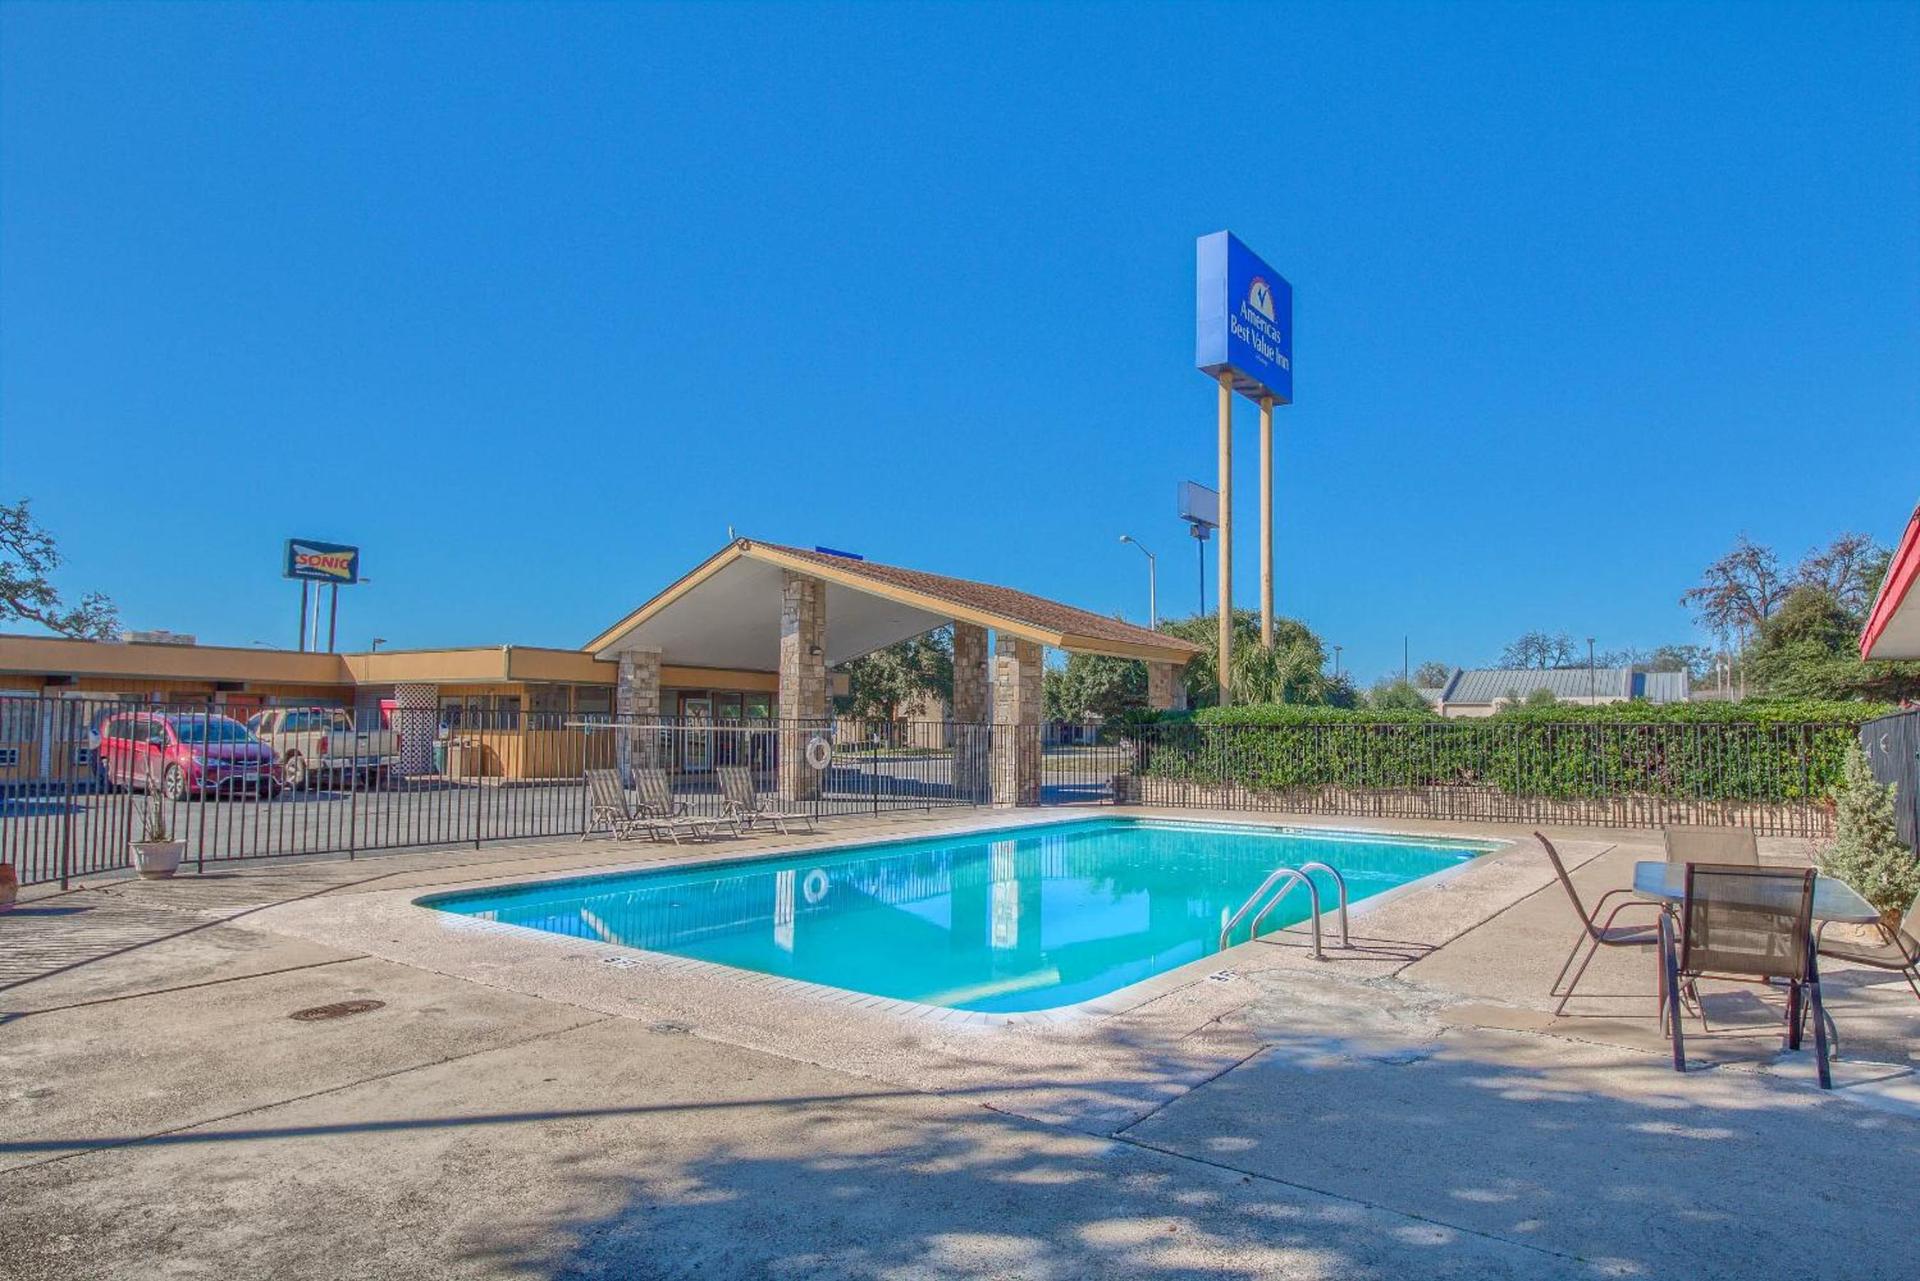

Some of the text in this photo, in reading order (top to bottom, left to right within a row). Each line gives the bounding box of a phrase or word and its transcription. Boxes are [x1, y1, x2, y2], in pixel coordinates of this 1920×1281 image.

[1231, 314, 1290, 371] Best Value Inn
[1240, 300, 1281, 343] Americas
[298, 554, 349, 569] SONIC
